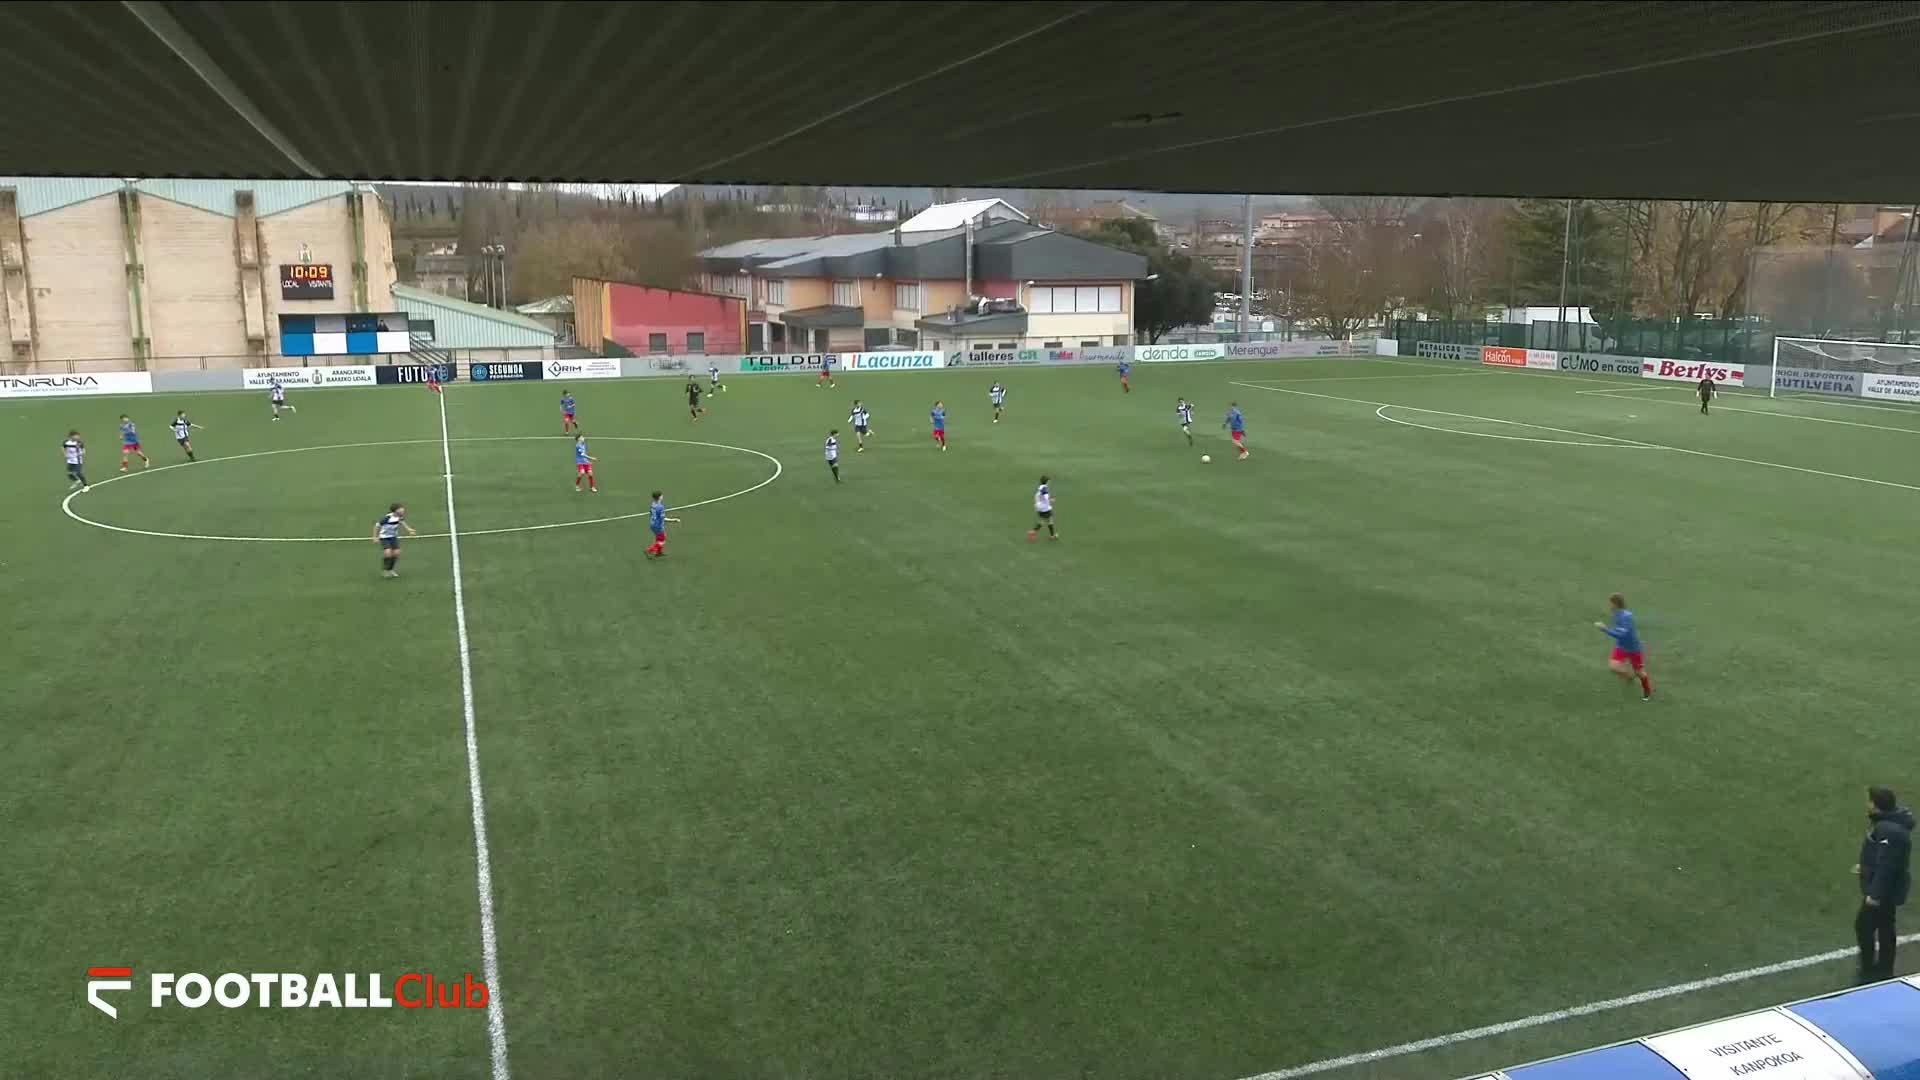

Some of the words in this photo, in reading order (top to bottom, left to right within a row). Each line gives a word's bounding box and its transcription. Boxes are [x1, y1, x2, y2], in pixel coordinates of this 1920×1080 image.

[282, 280, 299, 288] LOCAL
[969, 351, 1014, 361] talleres
[1018, 350, 1040, 360] CR
[1142, 346, 1189, 360] denda
[1227, 345, 1279, 356] Merengue
[1419, 351, 1461, 360] MUTILVA
[745, 355, 837, 366] TOLDOS
[489, 364, 524, 375] SEGUNDA
[1601, 363, 1614, 373] en
[1616, 363, 1640, 374] casa
[1803, 370, 1855, 381] DEPORTIVA
[1867, 386, 1884, 394] VALLE
[1708, 1032, 1783, 1057] VISITANTE
[1729, 1051, 1805, 1076] KANPOKOA
